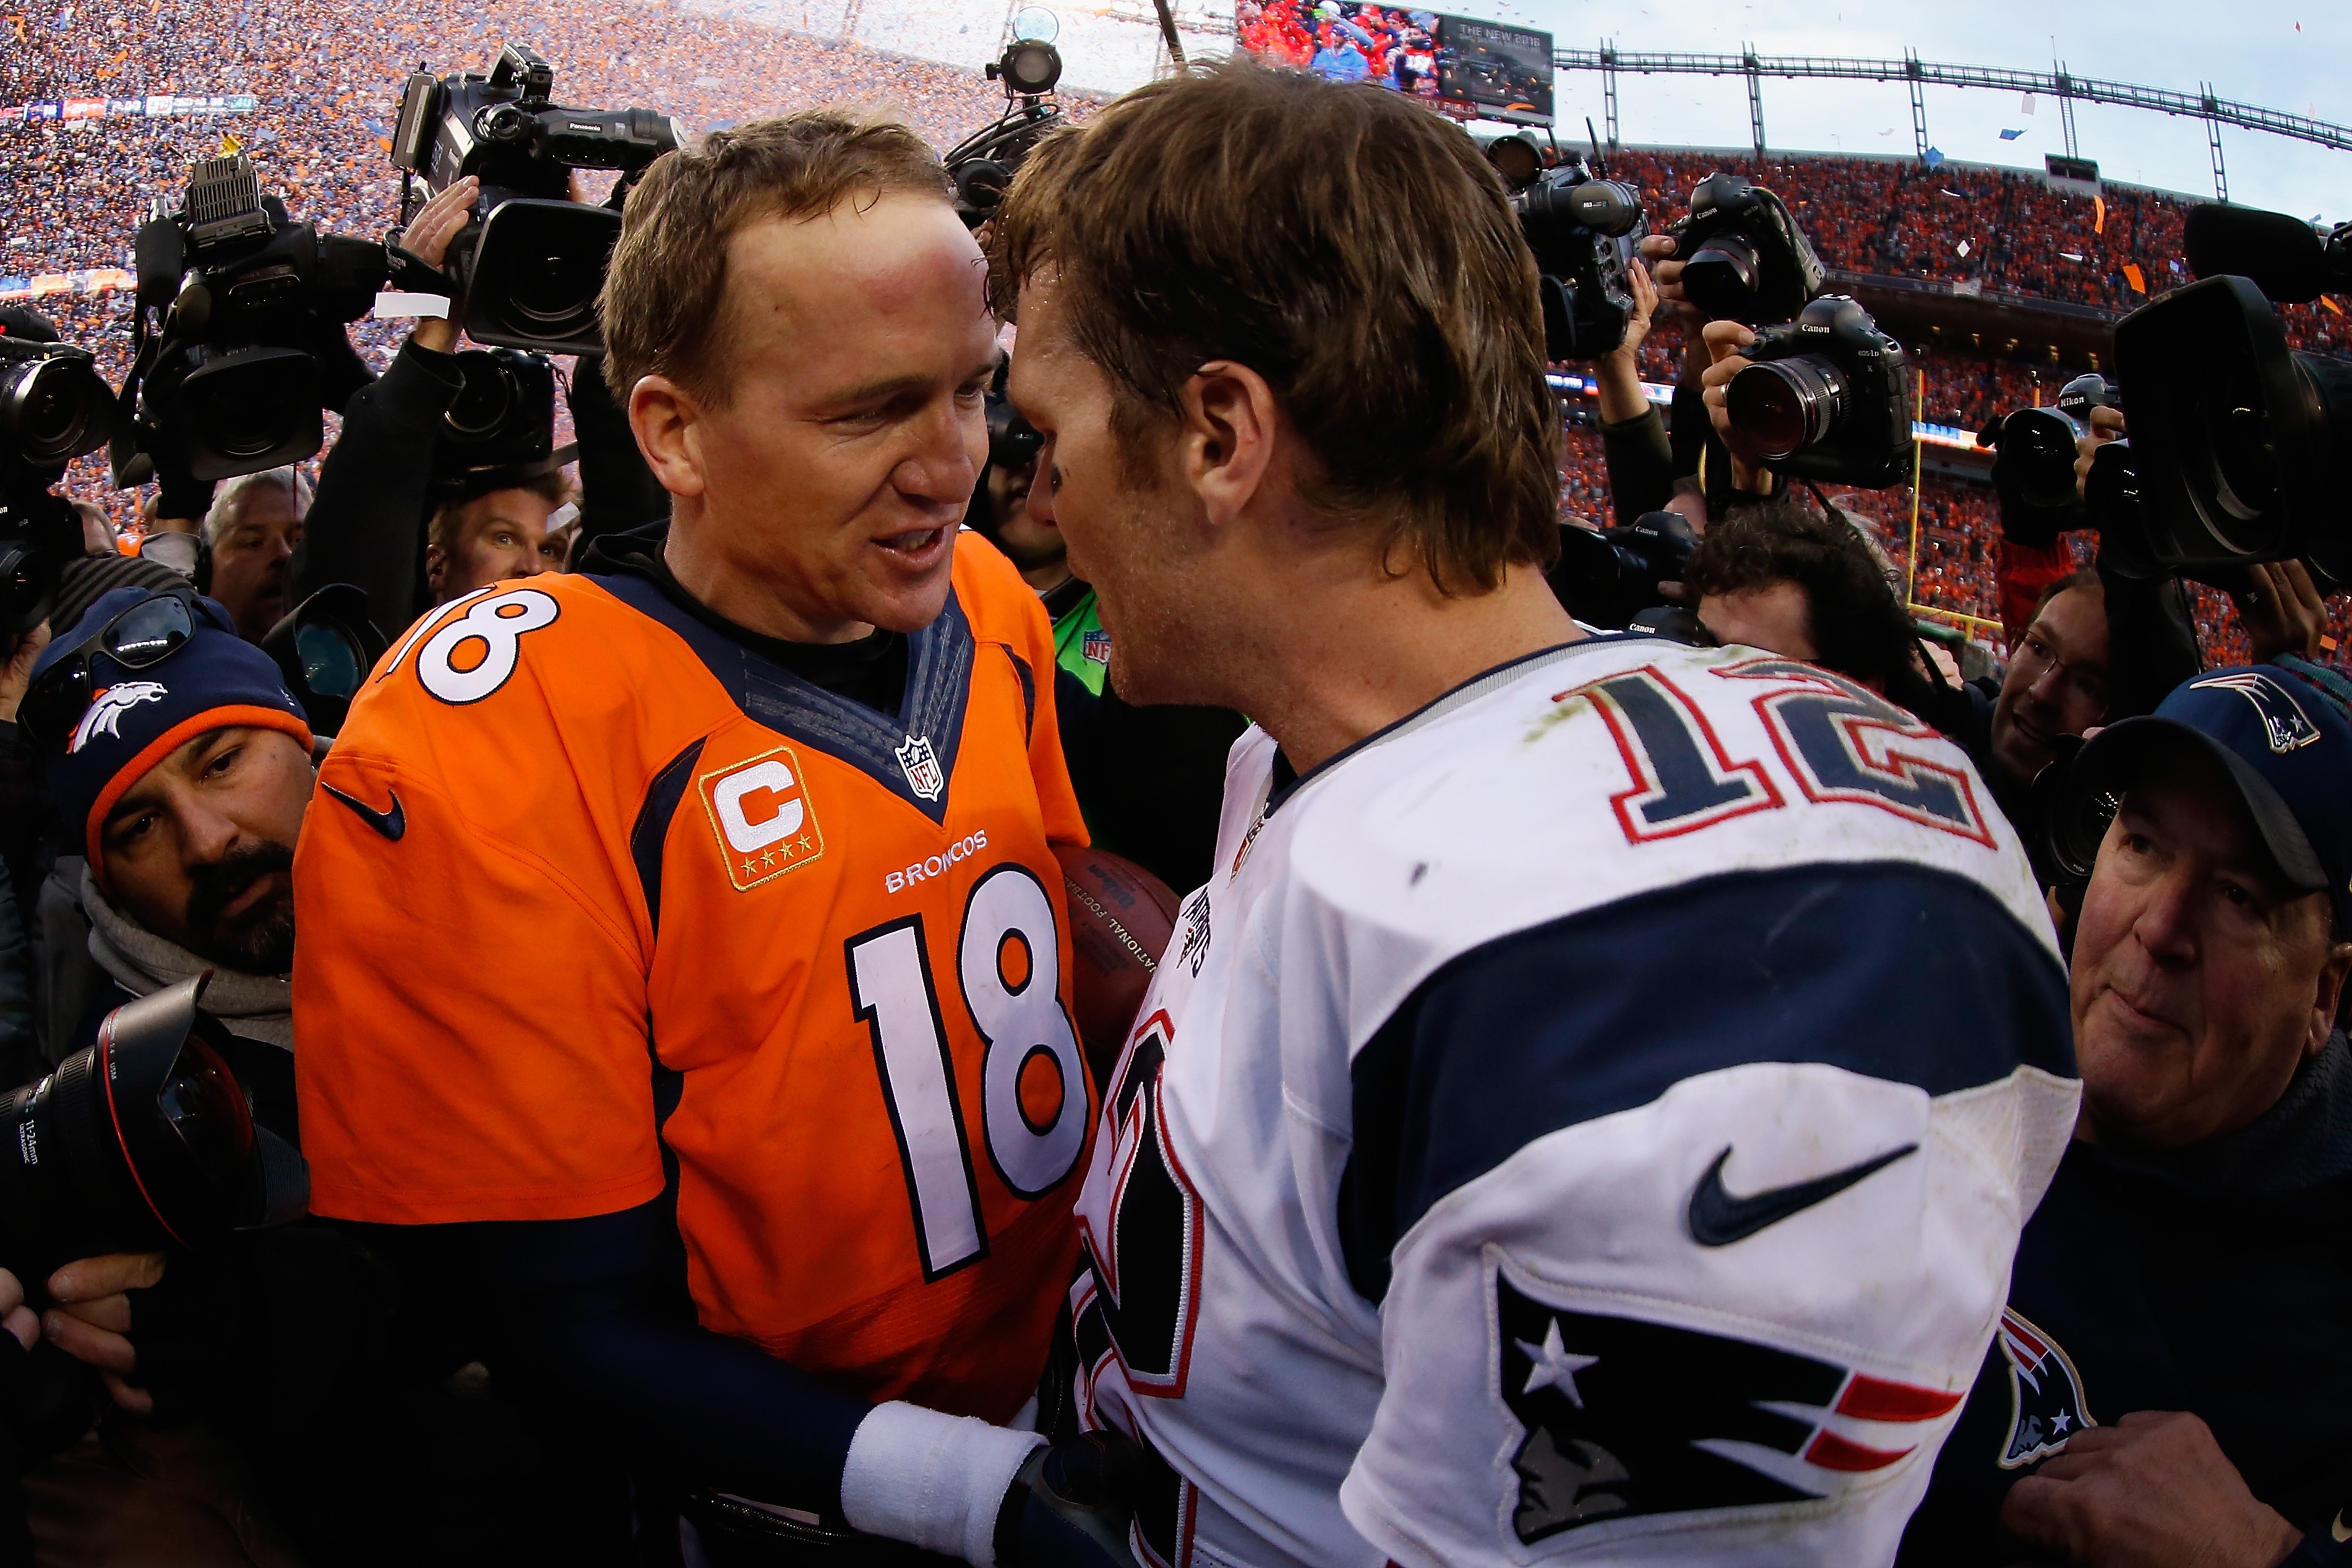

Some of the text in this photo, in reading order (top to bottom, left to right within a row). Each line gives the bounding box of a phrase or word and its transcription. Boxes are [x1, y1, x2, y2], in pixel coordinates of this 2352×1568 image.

[1459, 24, 1483, 36] THE
[1486, 28, 1512, 42] NEW
[1514, 33, 1540, 47] 2016
[1444, 101, 1475, 114] FIELD
[569, 122, 601, 131] Panasonic
[1696, 207, 1718, 220] Canon
[1801, 323, 1831, 333] Canon
[1866, 364, 1873, 373] X
[2061, 396, 2085, 408] Nikon
[1635, 525, 1659, 536] Canon
[1629, 622, 1655, 635] Canon
[376, 583, 561, 706] 18
[1088, 642, 1110, 661] NF
[1552, 658, 1999, 851] 12
[910, 762, 938, 790] NFL
[713, 760, 805, 853] C
[885, 829, 989, 894] BRONCOS
[1063, 874, 1108, 918] FOOTBAL
[844, 862, 1092, 1280] 18
[19, 1123, 30, 1165] ULTRASONIC
[25, 1118, 38, 1165] 11-24mm
